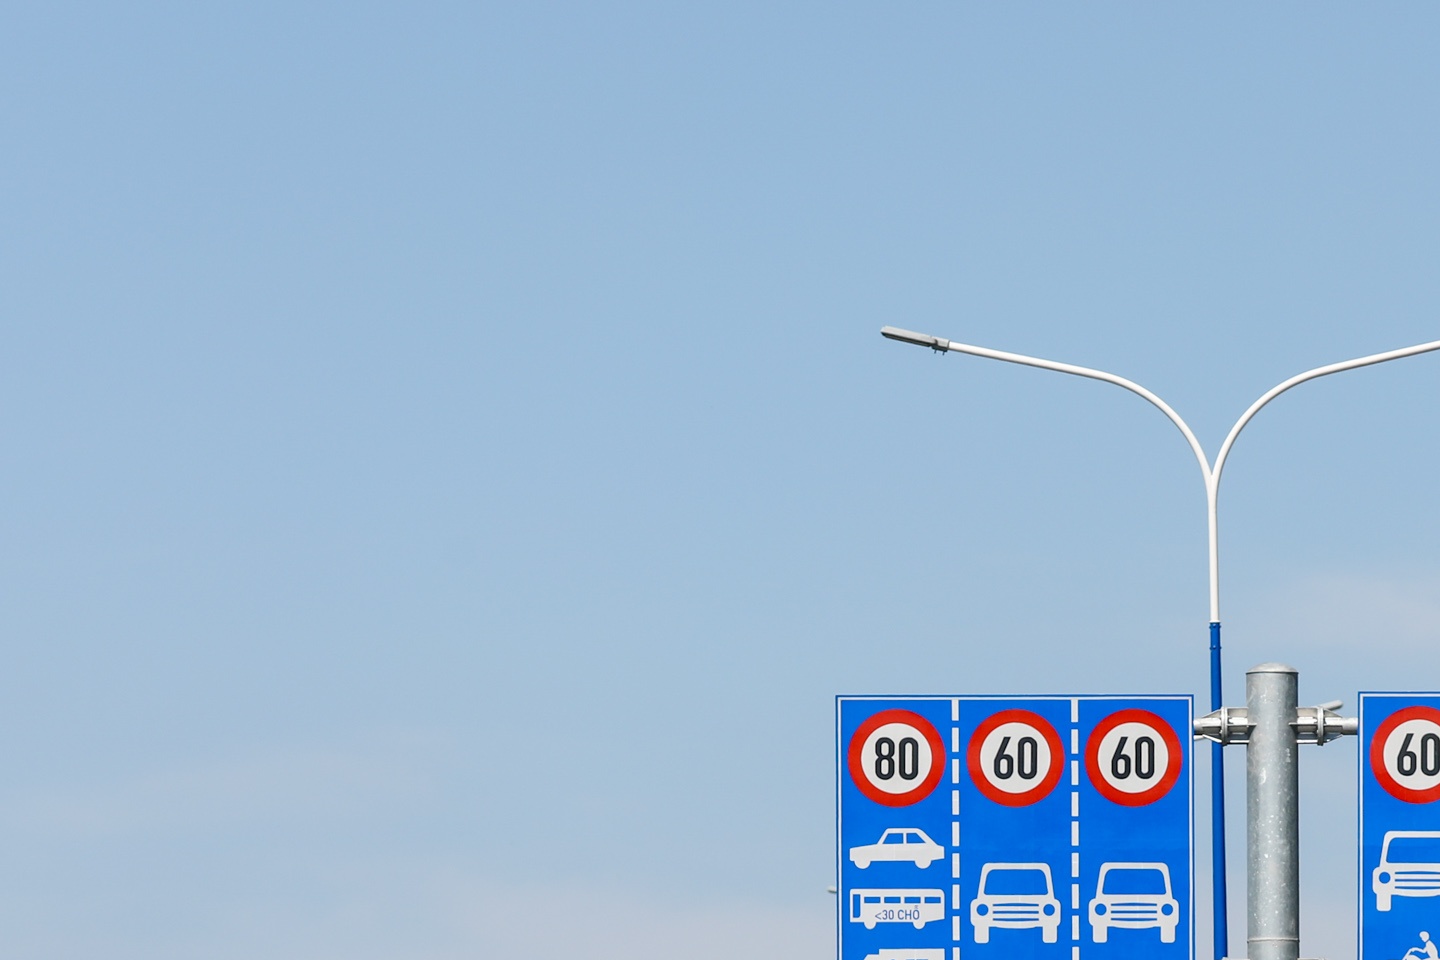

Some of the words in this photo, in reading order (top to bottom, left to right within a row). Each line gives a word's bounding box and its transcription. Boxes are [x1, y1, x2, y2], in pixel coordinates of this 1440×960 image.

[874, 736, 919, 781] 80
[993, 736, 1038, 780] 60
[1110, 736, 1155, 780] 60
[1396, 732, 1440, 777] 60
[874, 909, 895, 920] <30
